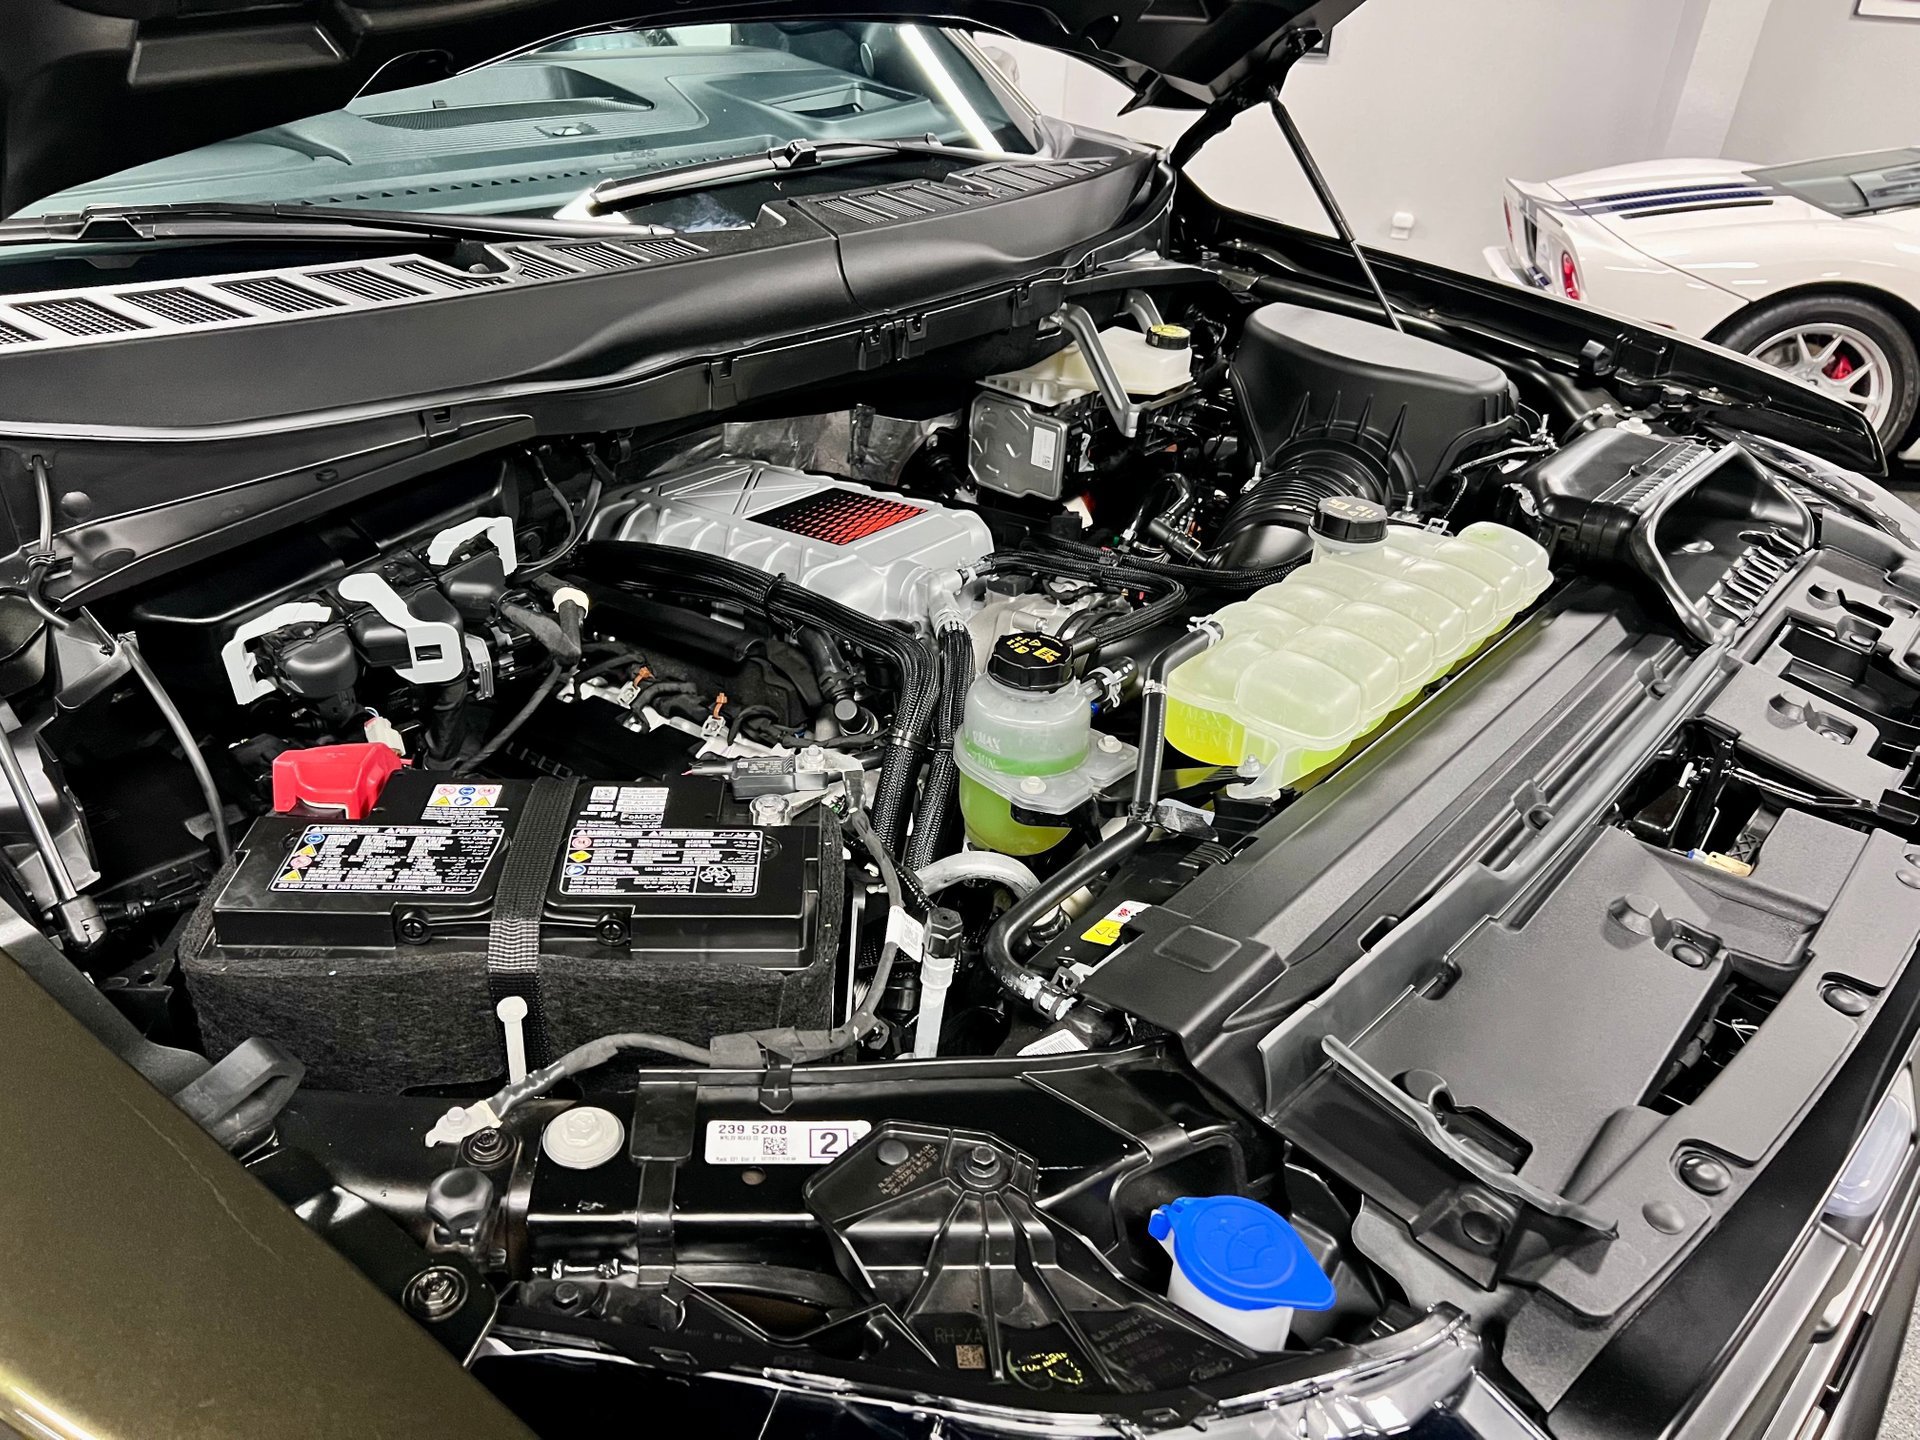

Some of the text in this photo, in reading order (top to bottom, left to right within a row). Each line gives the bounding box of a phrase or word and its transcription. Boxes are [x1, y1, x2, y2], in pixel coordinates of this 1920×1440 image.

[718, 1124, 787, 1135] 239 5208
[820, 1132, 839, 1155] 2
